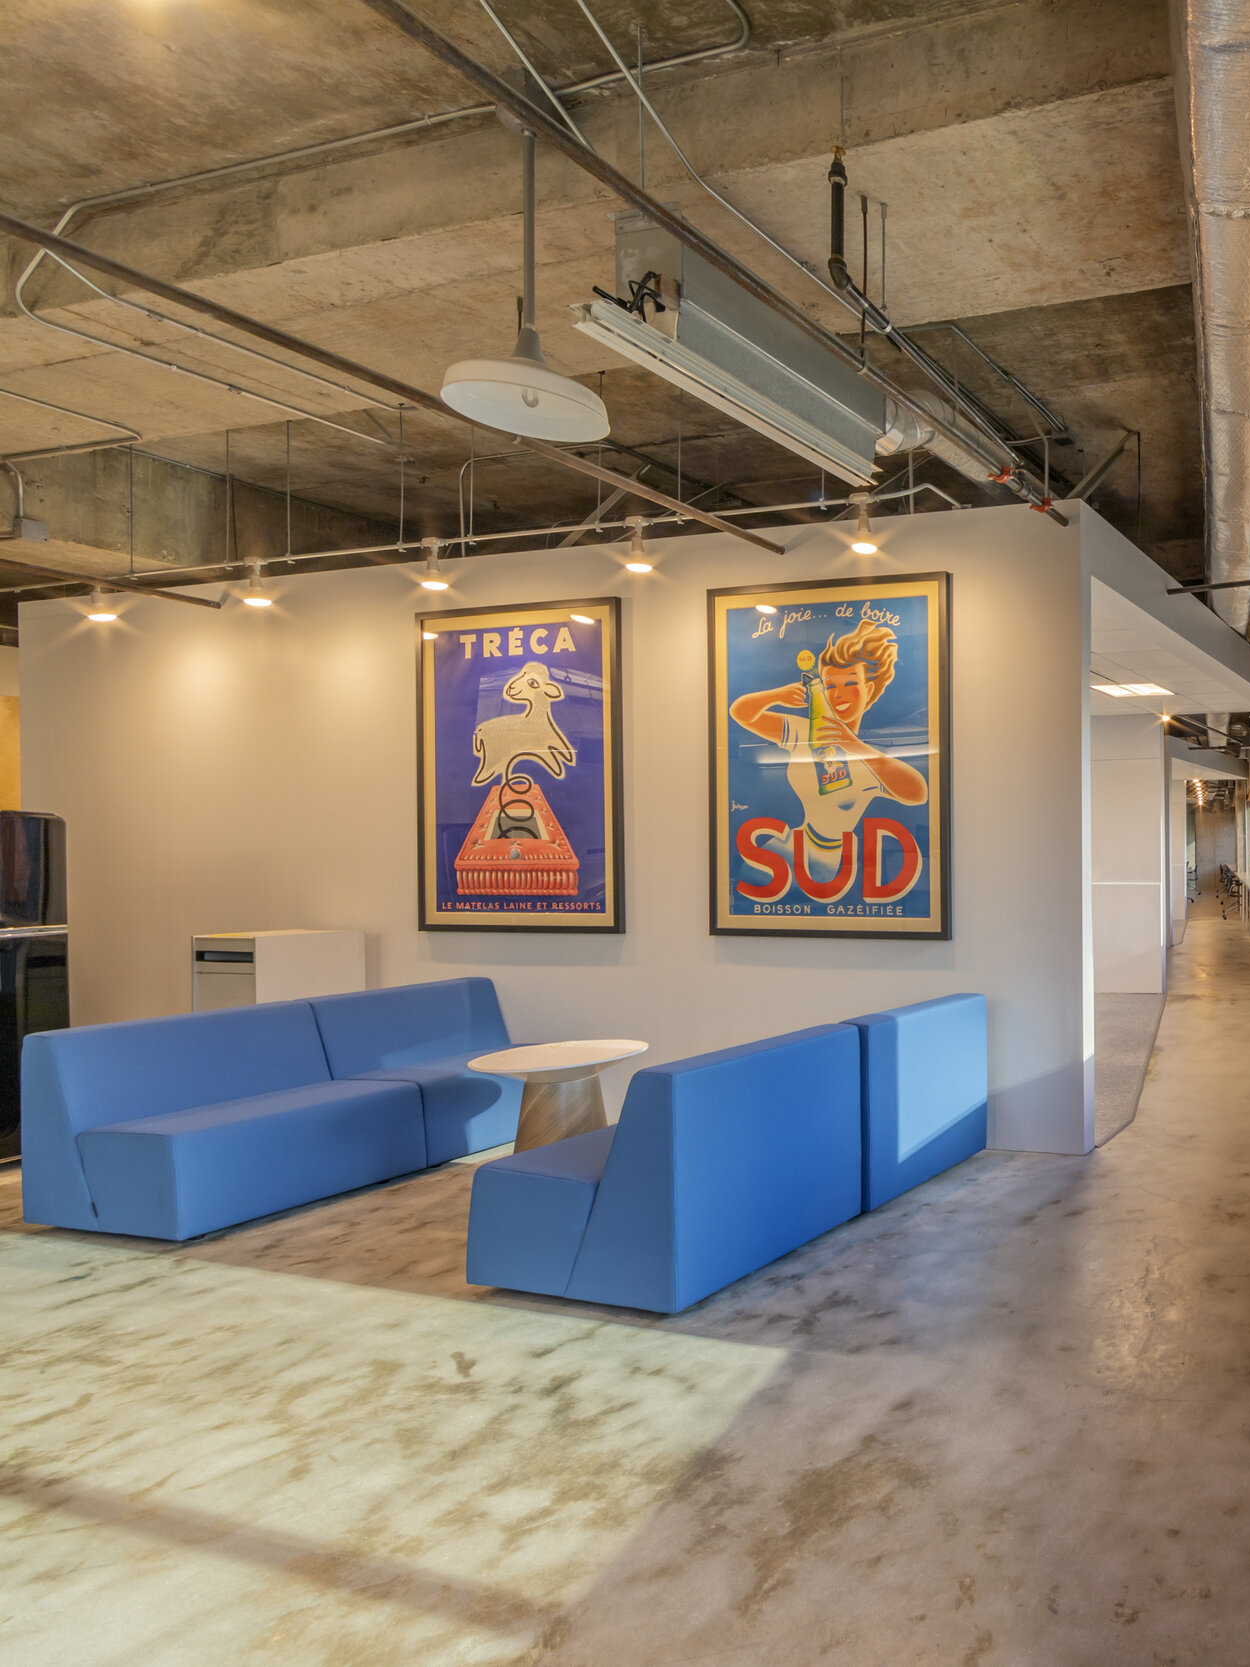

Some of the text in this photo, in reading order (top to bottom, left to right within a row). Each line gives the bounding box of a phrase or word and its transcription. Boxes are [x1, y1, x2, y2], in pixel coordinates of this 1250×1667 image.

[751, 616, 774, 639] La
[835, 603, 854, 618] de
[860, 601, 901, 627] boire
[459, 627, 577, 660] TRÉCA
[820, 768, 847, 785] SUD
[735, 816, 923, 904] SUD
[442, 902, 601, 910] LE MATELAS LAINE ET RESSORTS
[754, 903, 904, 916] BOISSON GAZÉIFIÉE
